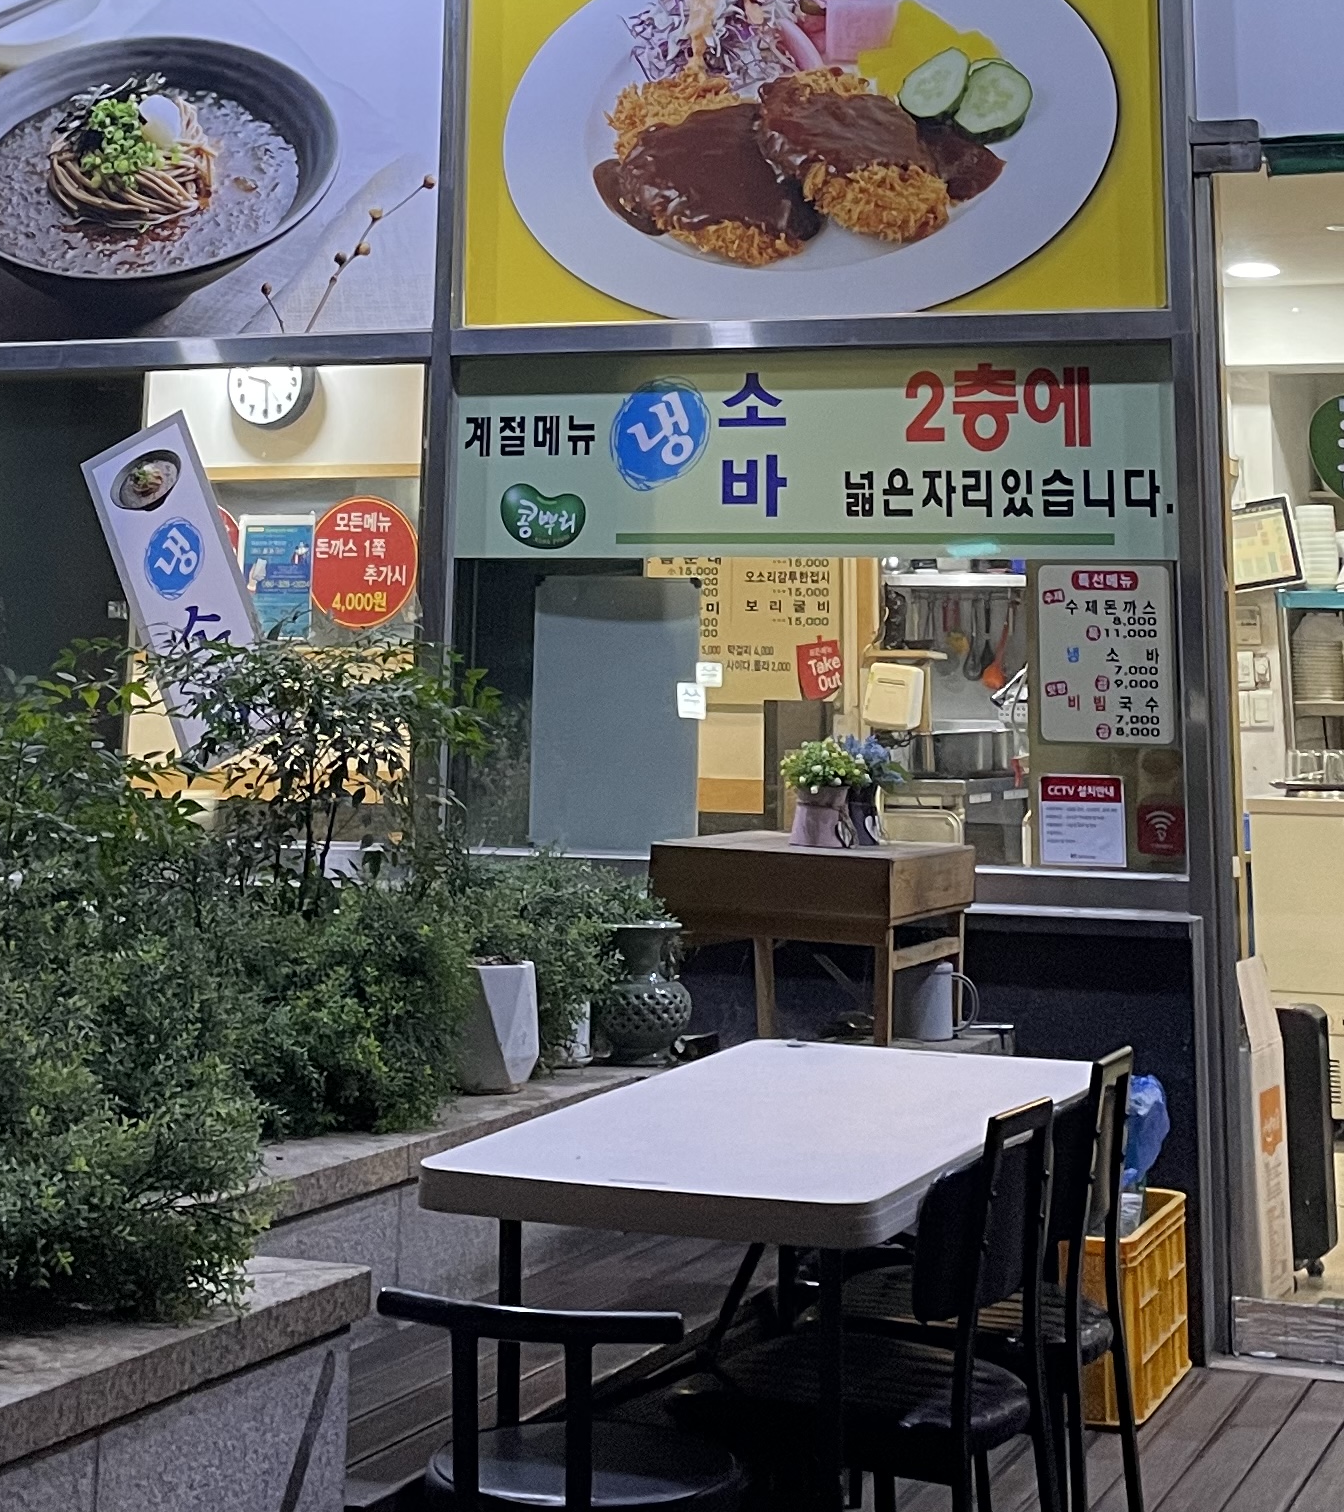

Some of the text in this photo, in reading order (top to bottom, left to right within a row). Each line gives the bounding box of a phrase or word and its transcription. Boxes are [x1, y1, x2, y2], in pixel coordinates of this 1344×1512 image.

[904, 363, 1092, 452] 2층에
[464, 390, 693, 465] 계절메뉴 냉
[718, 372, 788, 518] 소바
[843, 467, 1175, 520] 넓은자리있습니다.
[334, 512, 392, 533] 모든메뉴
[516, 499, 577, 538] 콩뿌리
[153, 526, 200, 576] 냉
[315, 538, 386, 559] 돈까스 1쪽
[363, 564, 407, 586] 추가시
[331, 592, 388, 613] 4,000원
[807, 654, 842, 677] Take
[817, 671, 843, 693] Out
[1047, 785, 1075, 796] CCTV
